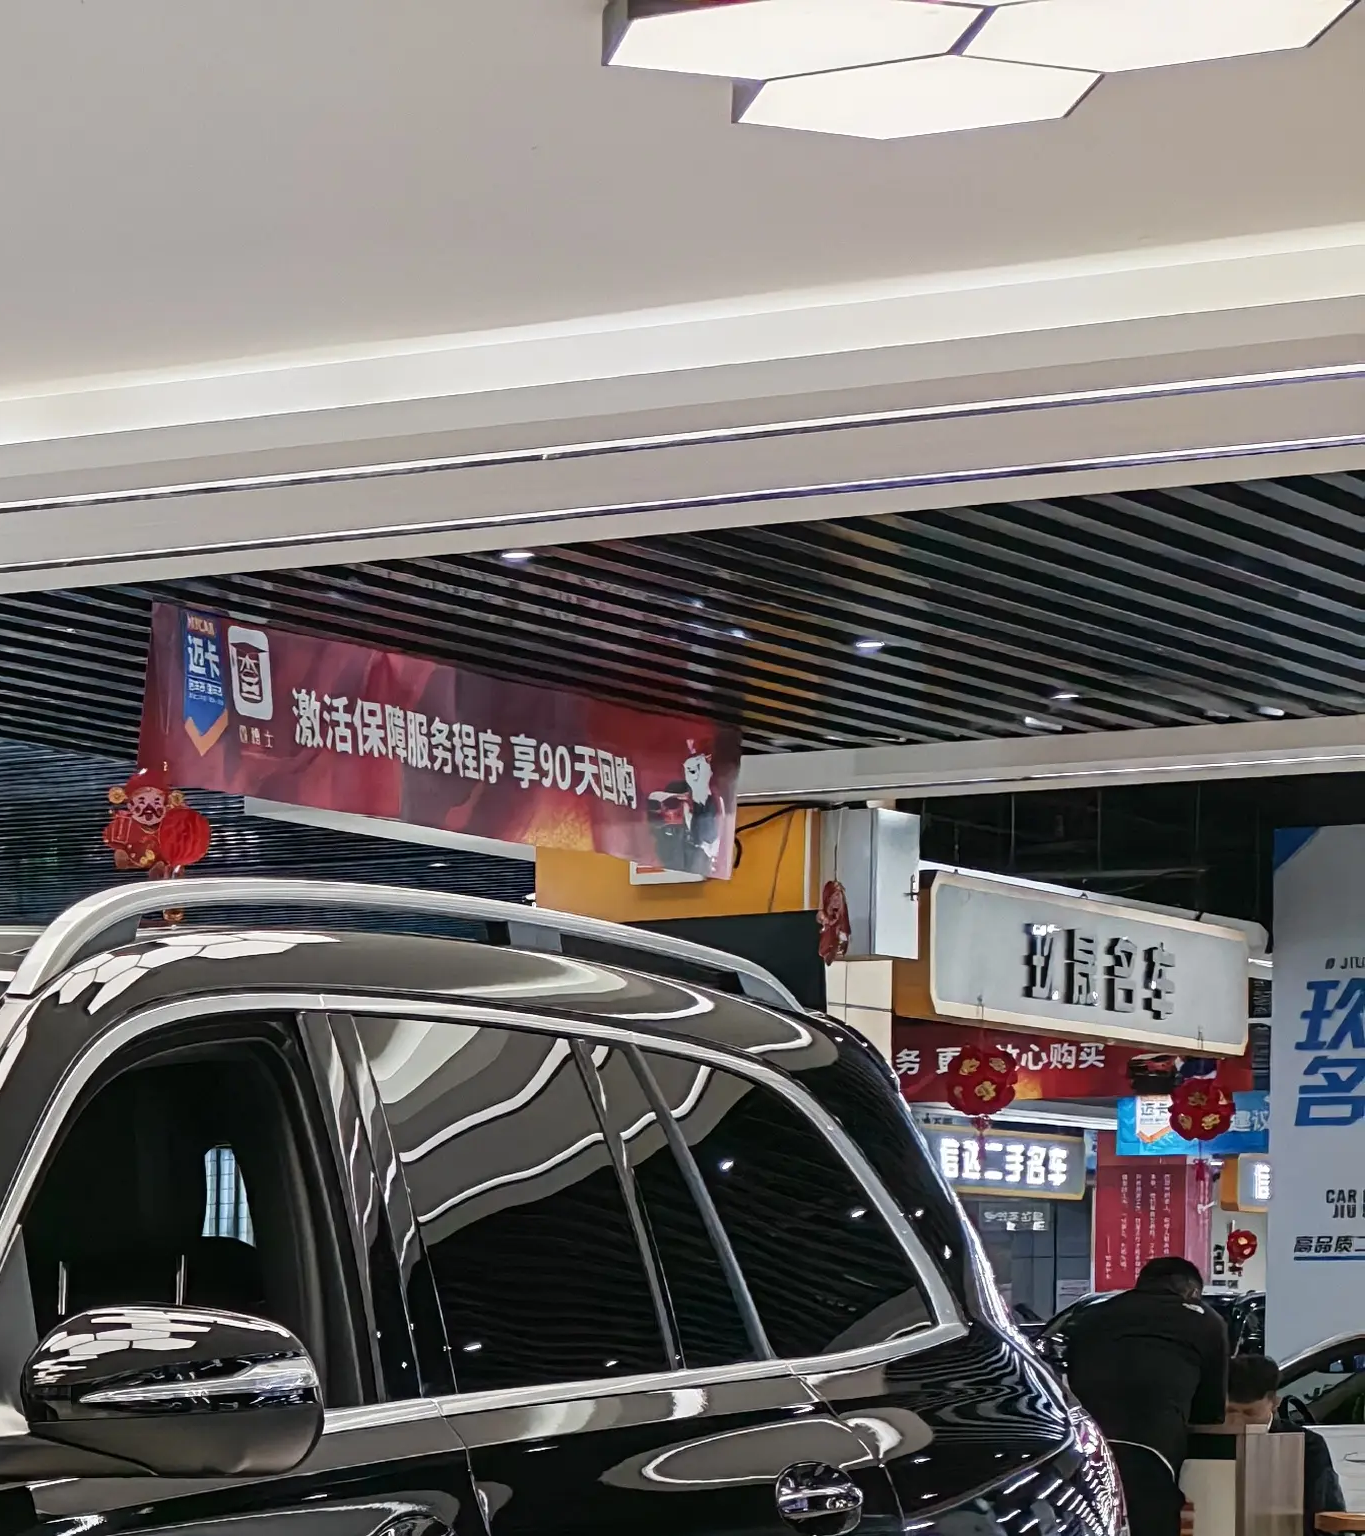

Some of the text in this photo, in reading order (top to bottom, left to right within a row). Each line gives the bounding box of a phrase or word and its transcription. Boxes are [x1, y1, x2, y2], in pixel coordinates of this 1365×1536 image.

[292, 688, 637, 809] 激活保障服务程序 享90天回购
[896, 1049, 920, 1075] 务
[1294, 1056, 1365, 1127] 名
[1326, 1189, 1356, 1204] CAR
[1332, 1204, 1356, 1219] JIU
